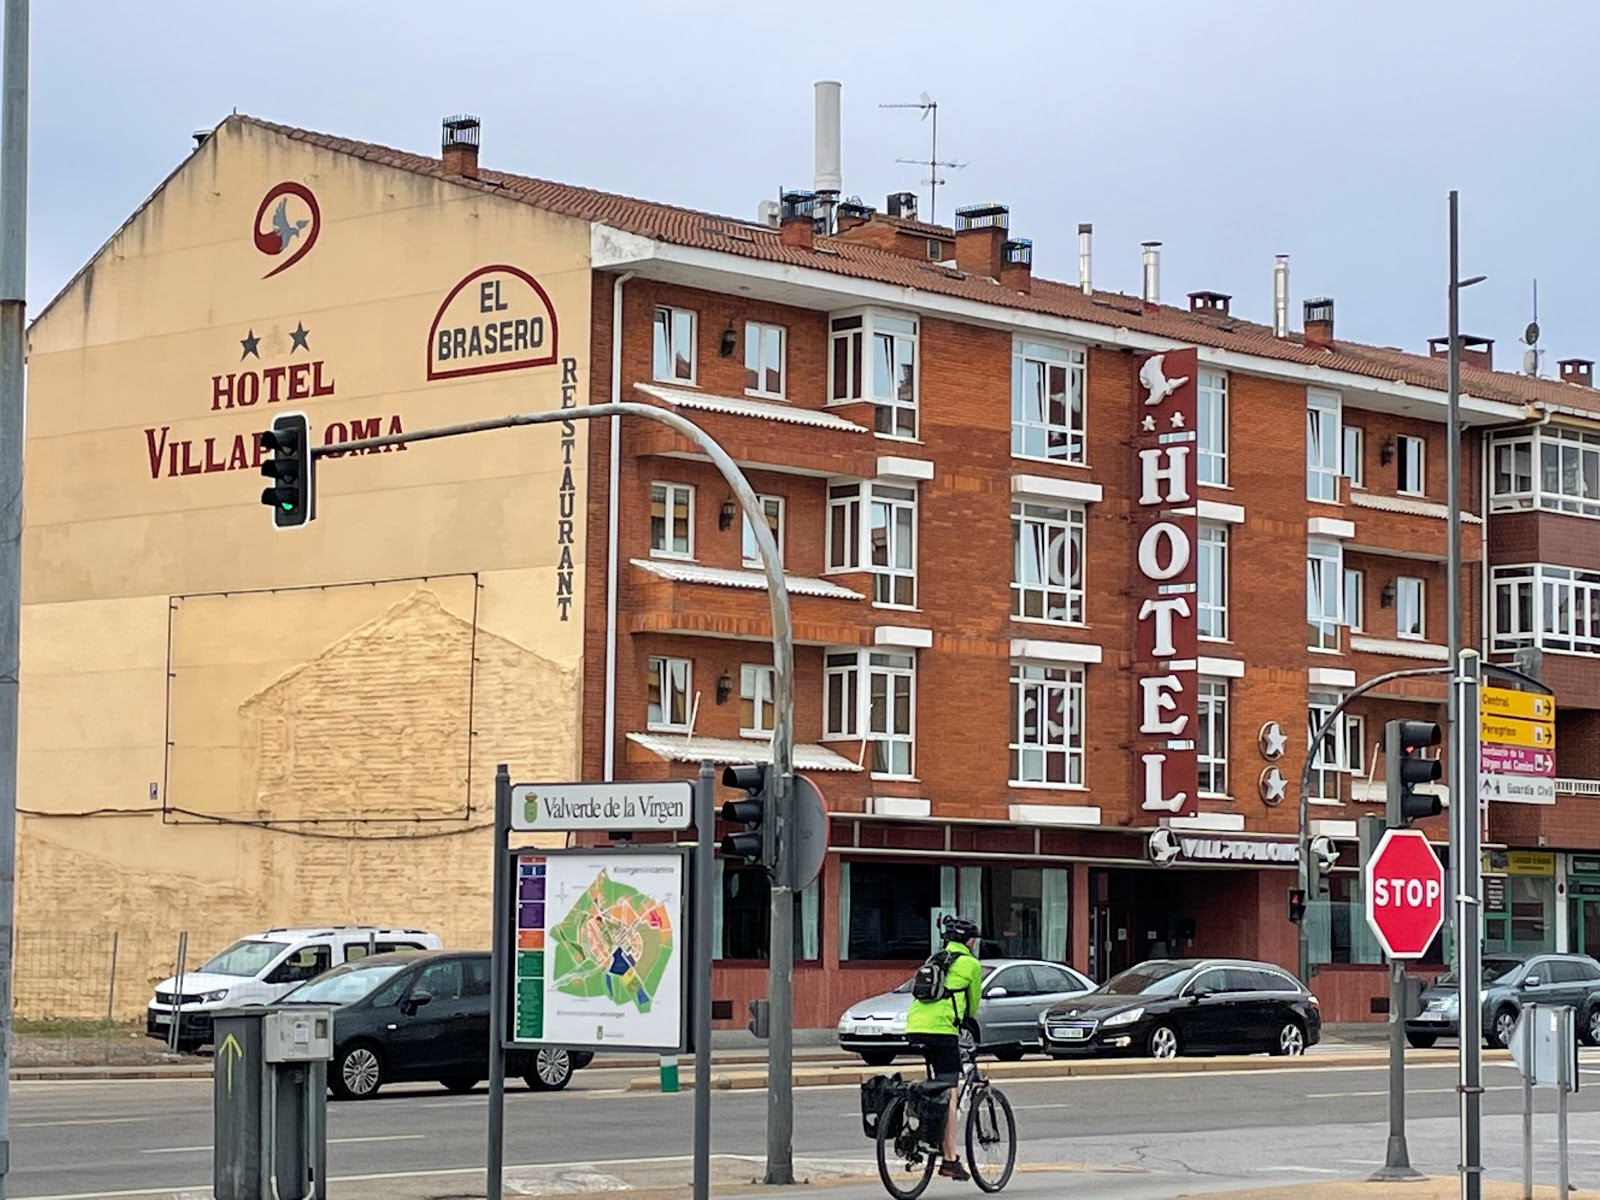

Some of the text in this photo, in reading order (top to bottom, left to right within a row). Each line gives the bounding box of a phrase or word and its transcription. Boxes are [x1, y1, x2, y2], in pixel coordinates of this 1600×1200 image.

[480, 279, 509, 314] EL
[437, 316, 544, 361] BRASERO
[211, 361, 335, 411] HOTEL
[144, 415, 408, 479] VILLAPOMA
[556, 357, 578, 622] RESTAURANT
[1138, 445, 1191, 813] HOTEL
[1482, 693, 1510, 707] Central
[544, 795, 683, 823] Valverde de la Virgen
[1507, 783, 1553, 797] Guardia Civil
[1374, 878, 1440, 908] STOP
